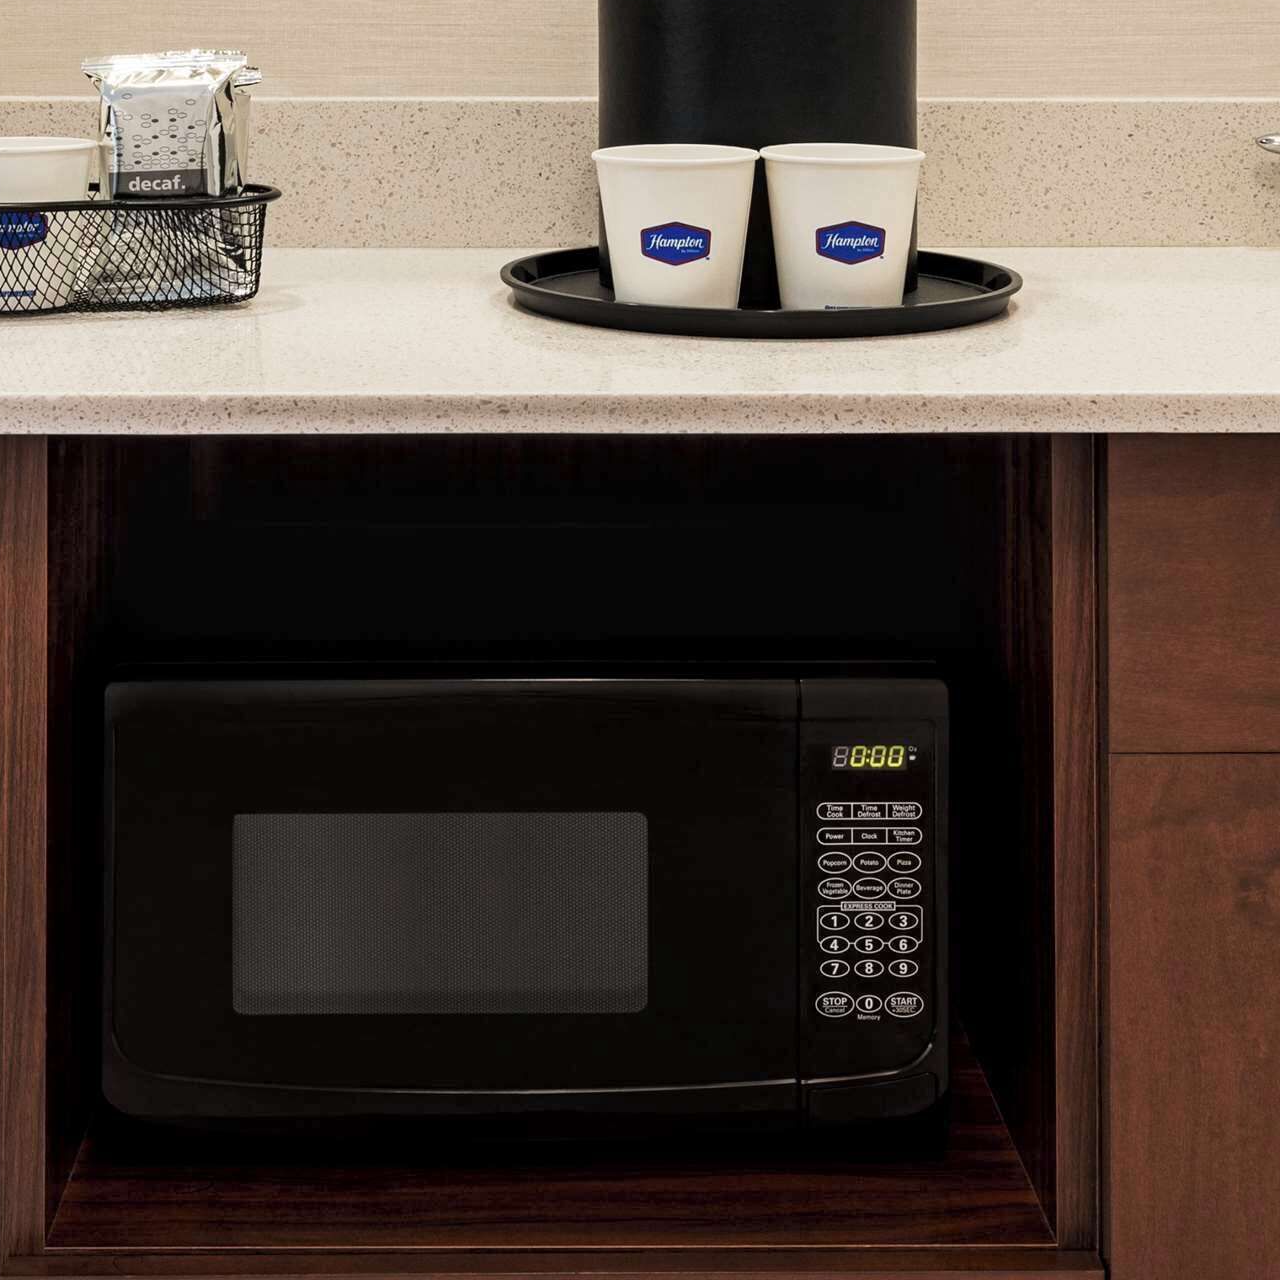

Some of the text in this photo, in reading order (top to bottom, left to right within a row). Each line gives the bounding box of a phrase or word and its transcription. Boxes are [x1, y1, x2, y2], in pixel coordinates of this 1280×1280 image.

[128, 174, 186, 191] decaf.
[646, 233, 705, 251] Hampton
[821, 233, 880, 250] Hampton
[892, 804, 916, 812] Weight
[823, 859, 847, 867] Popcorn
[822, 888, 848, 896] Vegetable
[855, 884, 883, 892] Beverage
[830, 915, 838, 927] 1
[864, 915, 873, 927] 2
[899, 915, 908, 927] 3
[829, 939, 839, 951] 4
[864, 939, 873, 951] 5
[899, 939, 908, 951] 6
[830, 963, 840, 975] 7
[864, 962, 873, 974] 8
[899, 962, 908, 974] 9
[822, 997, 848, 1006] STOP
[864, 997, 873, 1010] 0
[890, 997, 917, 1006] START
